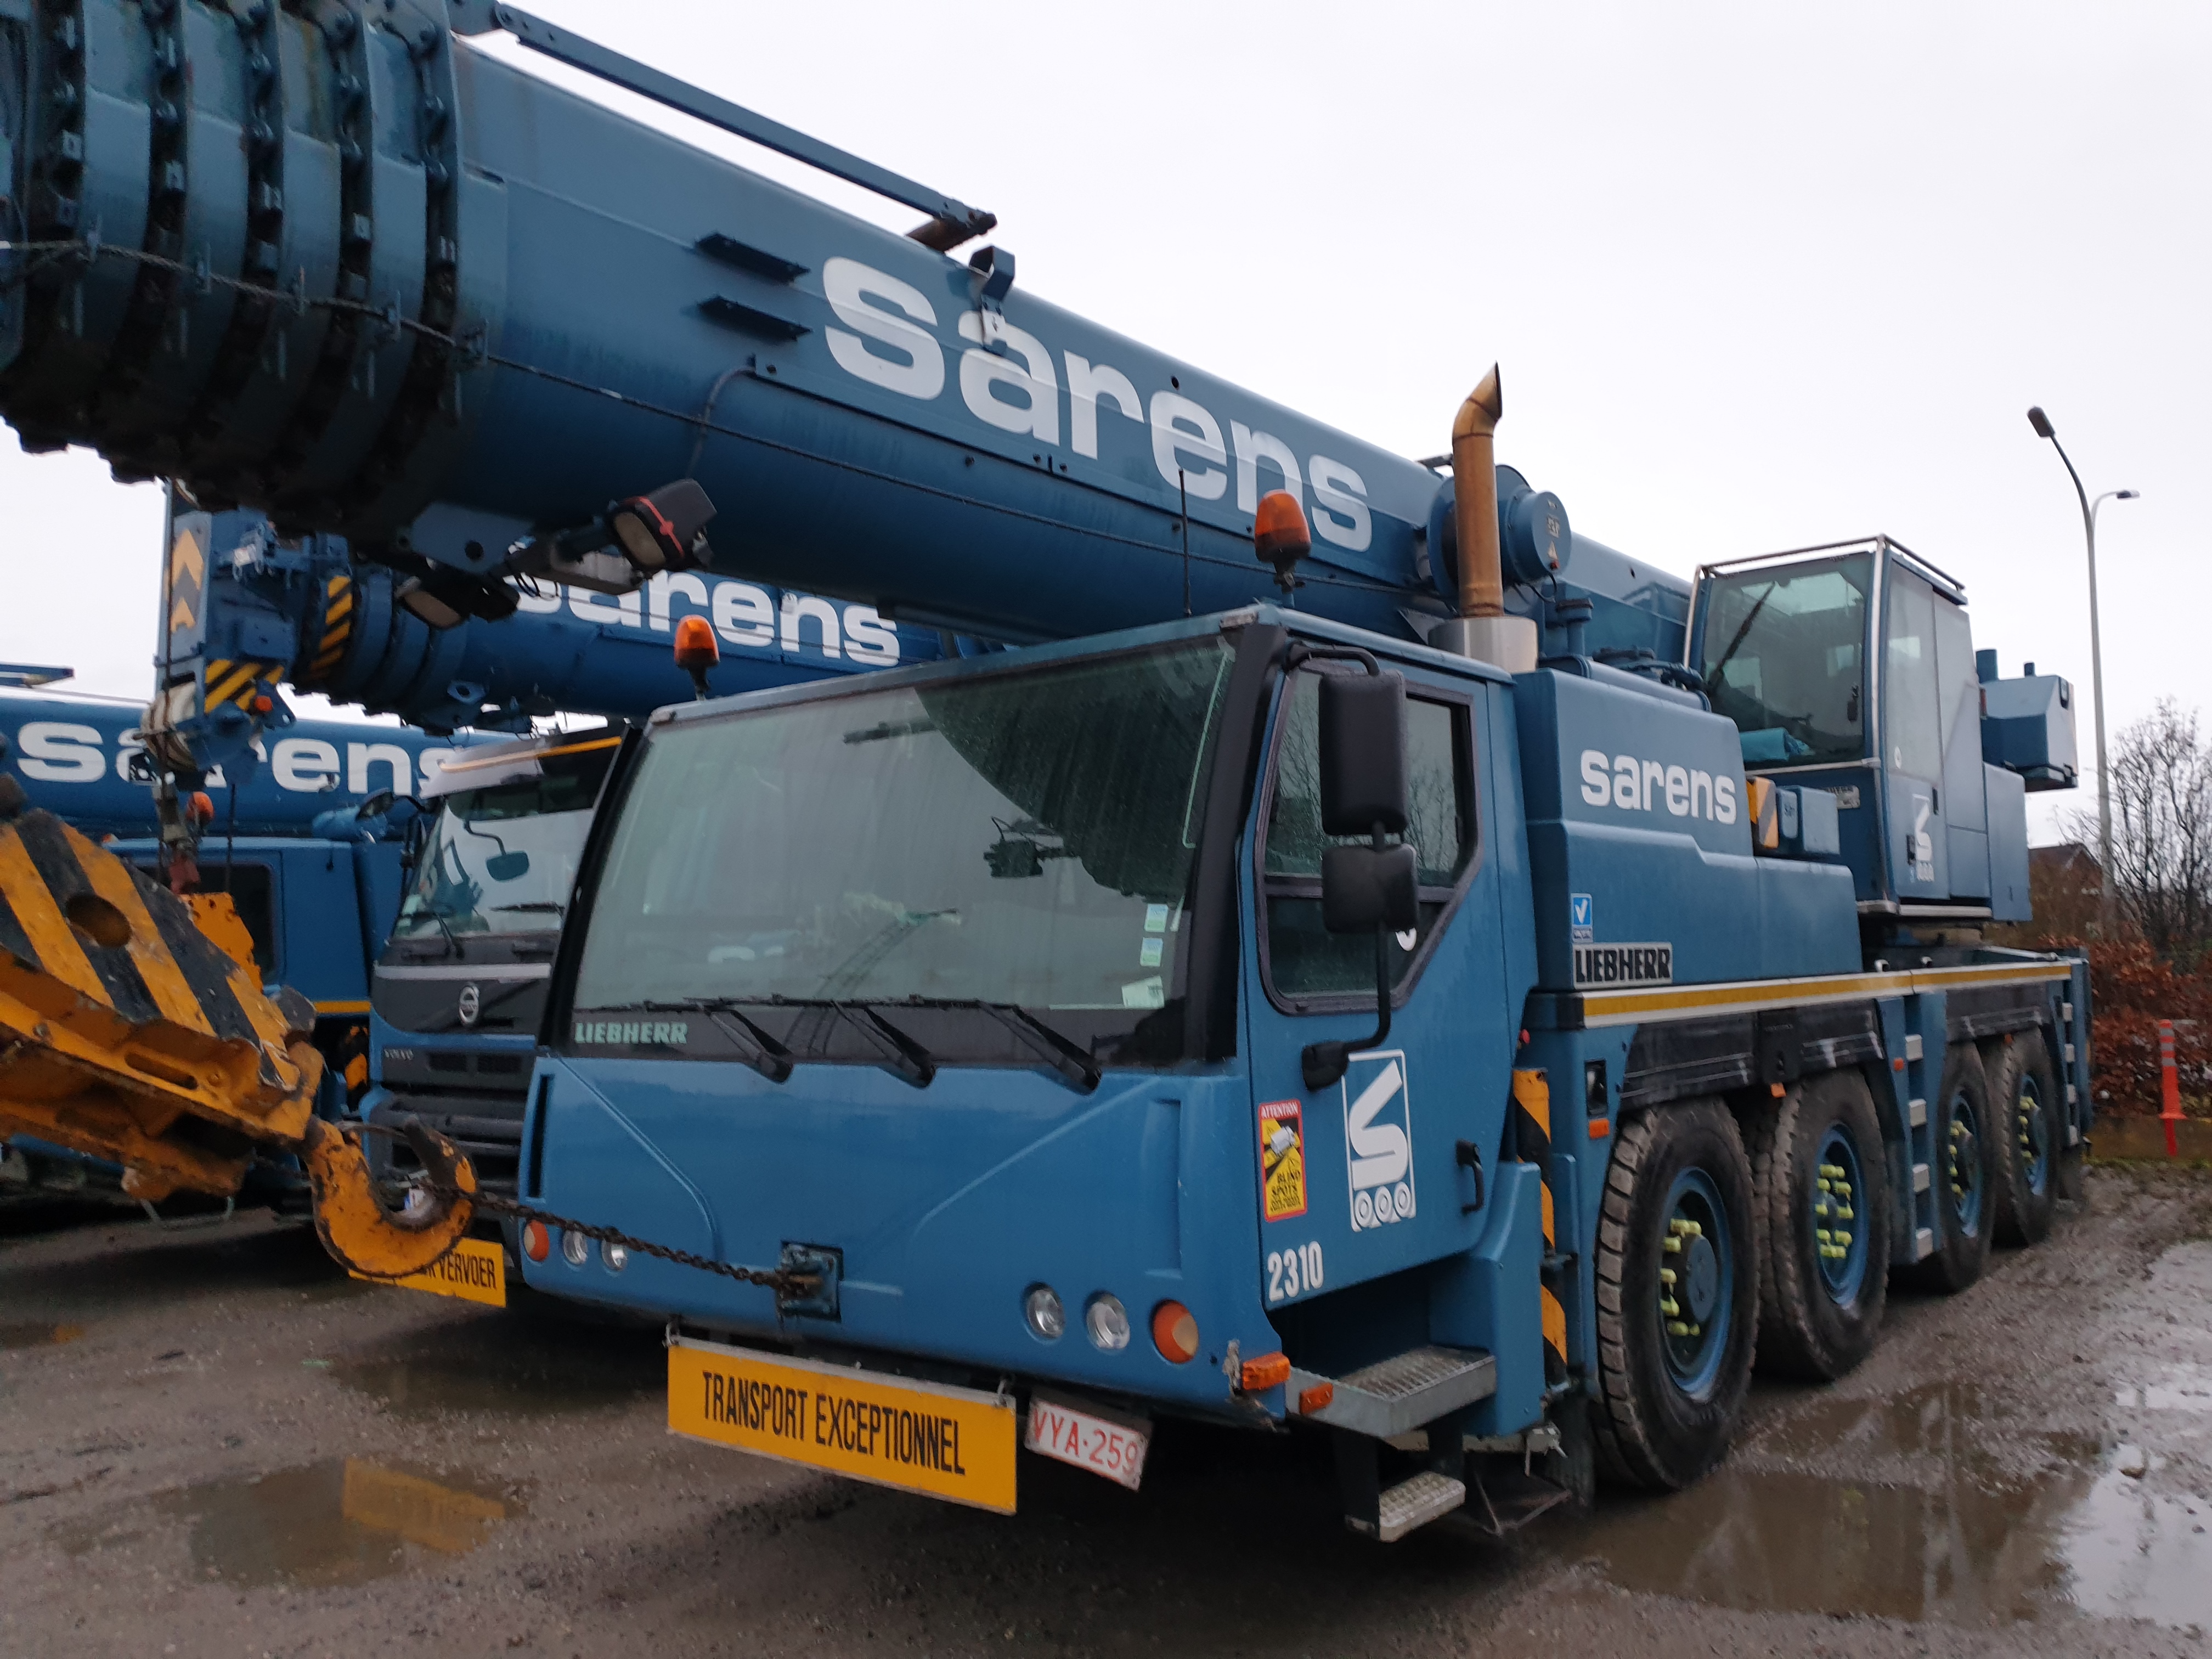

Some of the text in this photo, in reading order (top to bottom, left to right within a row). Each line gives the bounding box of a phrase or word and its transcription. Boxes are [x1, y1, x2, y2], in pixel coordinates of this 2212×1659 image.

[823, 256, 1373, 551] sarens
[17, 721, 456, 797] sen
[1580, 749, 1737, 825] sarens
[1575, 948, 1671, 983] LIEBHERR
[574, 1022, 688, 1043] LIEBHERR
[439, 1252, 497, 1290] VERVOER
[1267, 1240, 1324, 1302] 2310
[702, 1370, 966, 1476] TRANSPORT EXCEPTIONNEL
